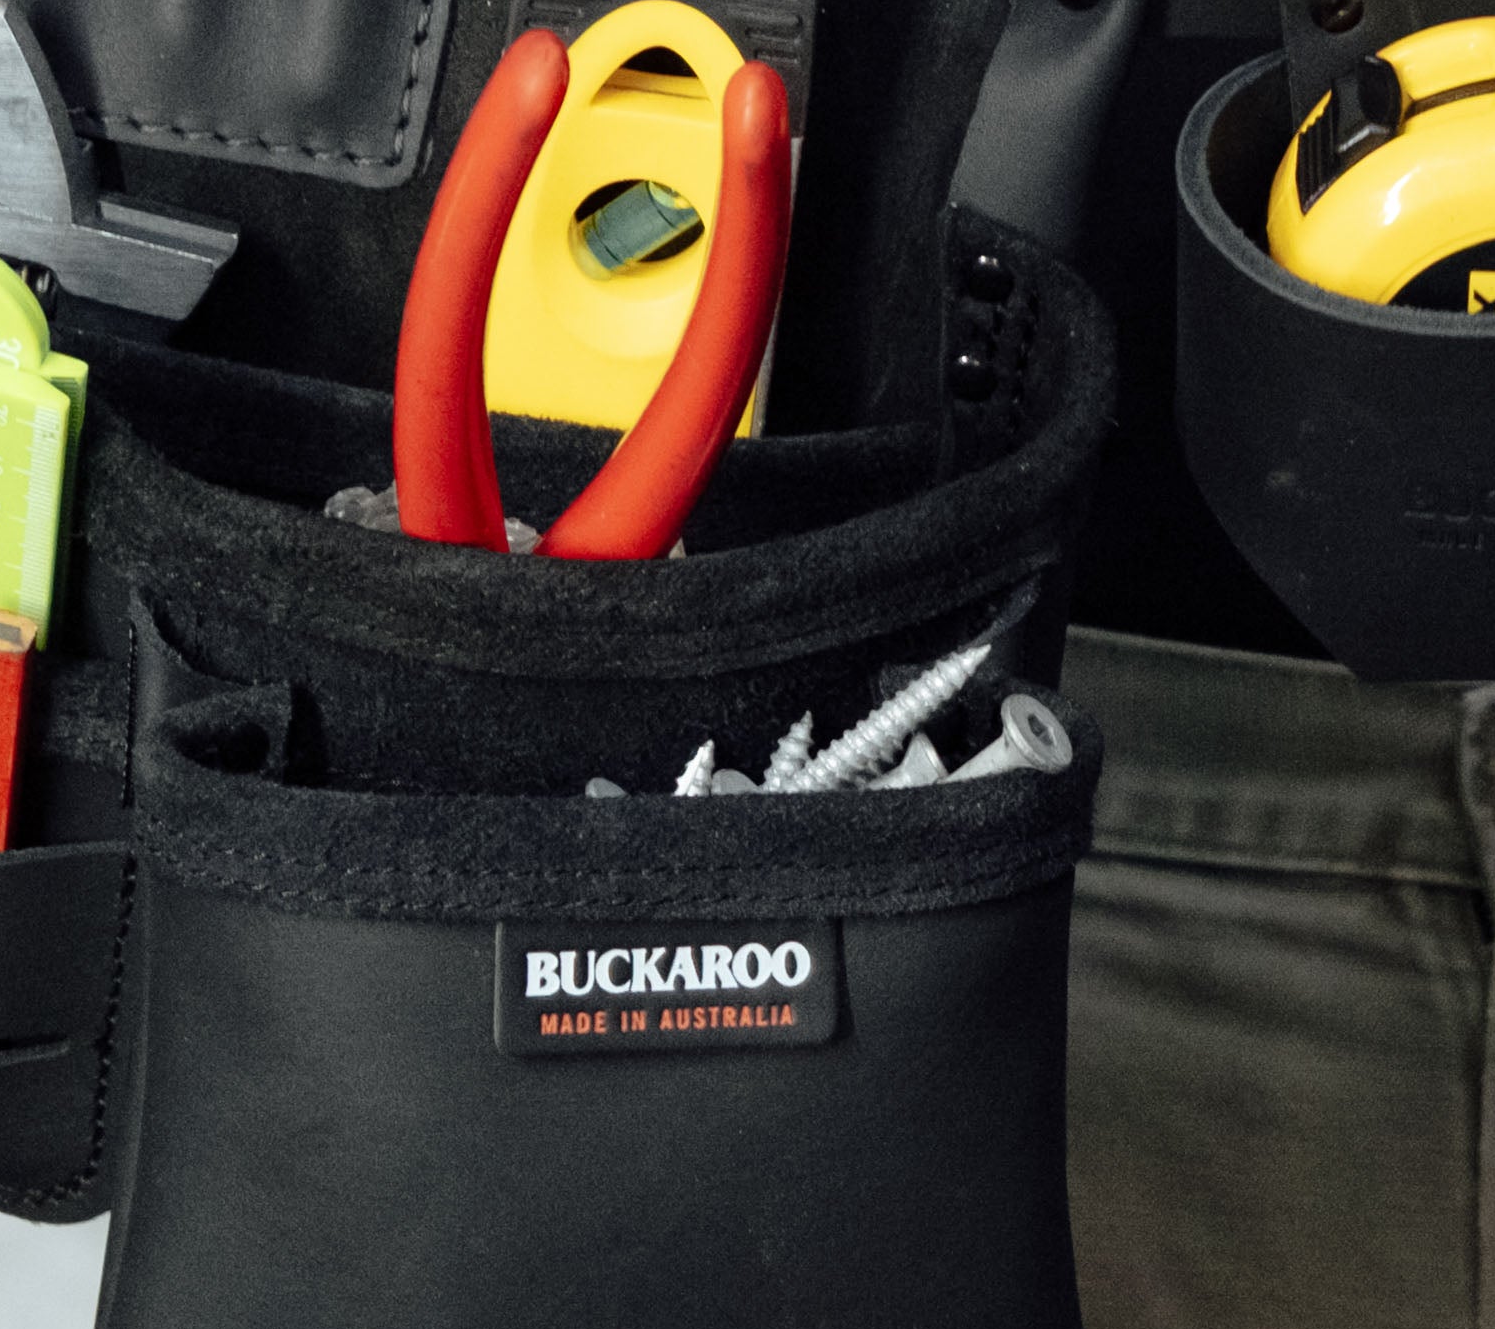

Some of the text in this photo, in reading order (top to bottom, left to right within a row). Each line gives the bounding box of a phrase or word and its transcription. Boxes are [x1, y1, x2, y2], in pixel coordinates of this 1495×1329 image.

[525, 940, 811, 997] BUCKAROO
[540, 1004, 795, 1035] MADE IN AUSTRALIA
